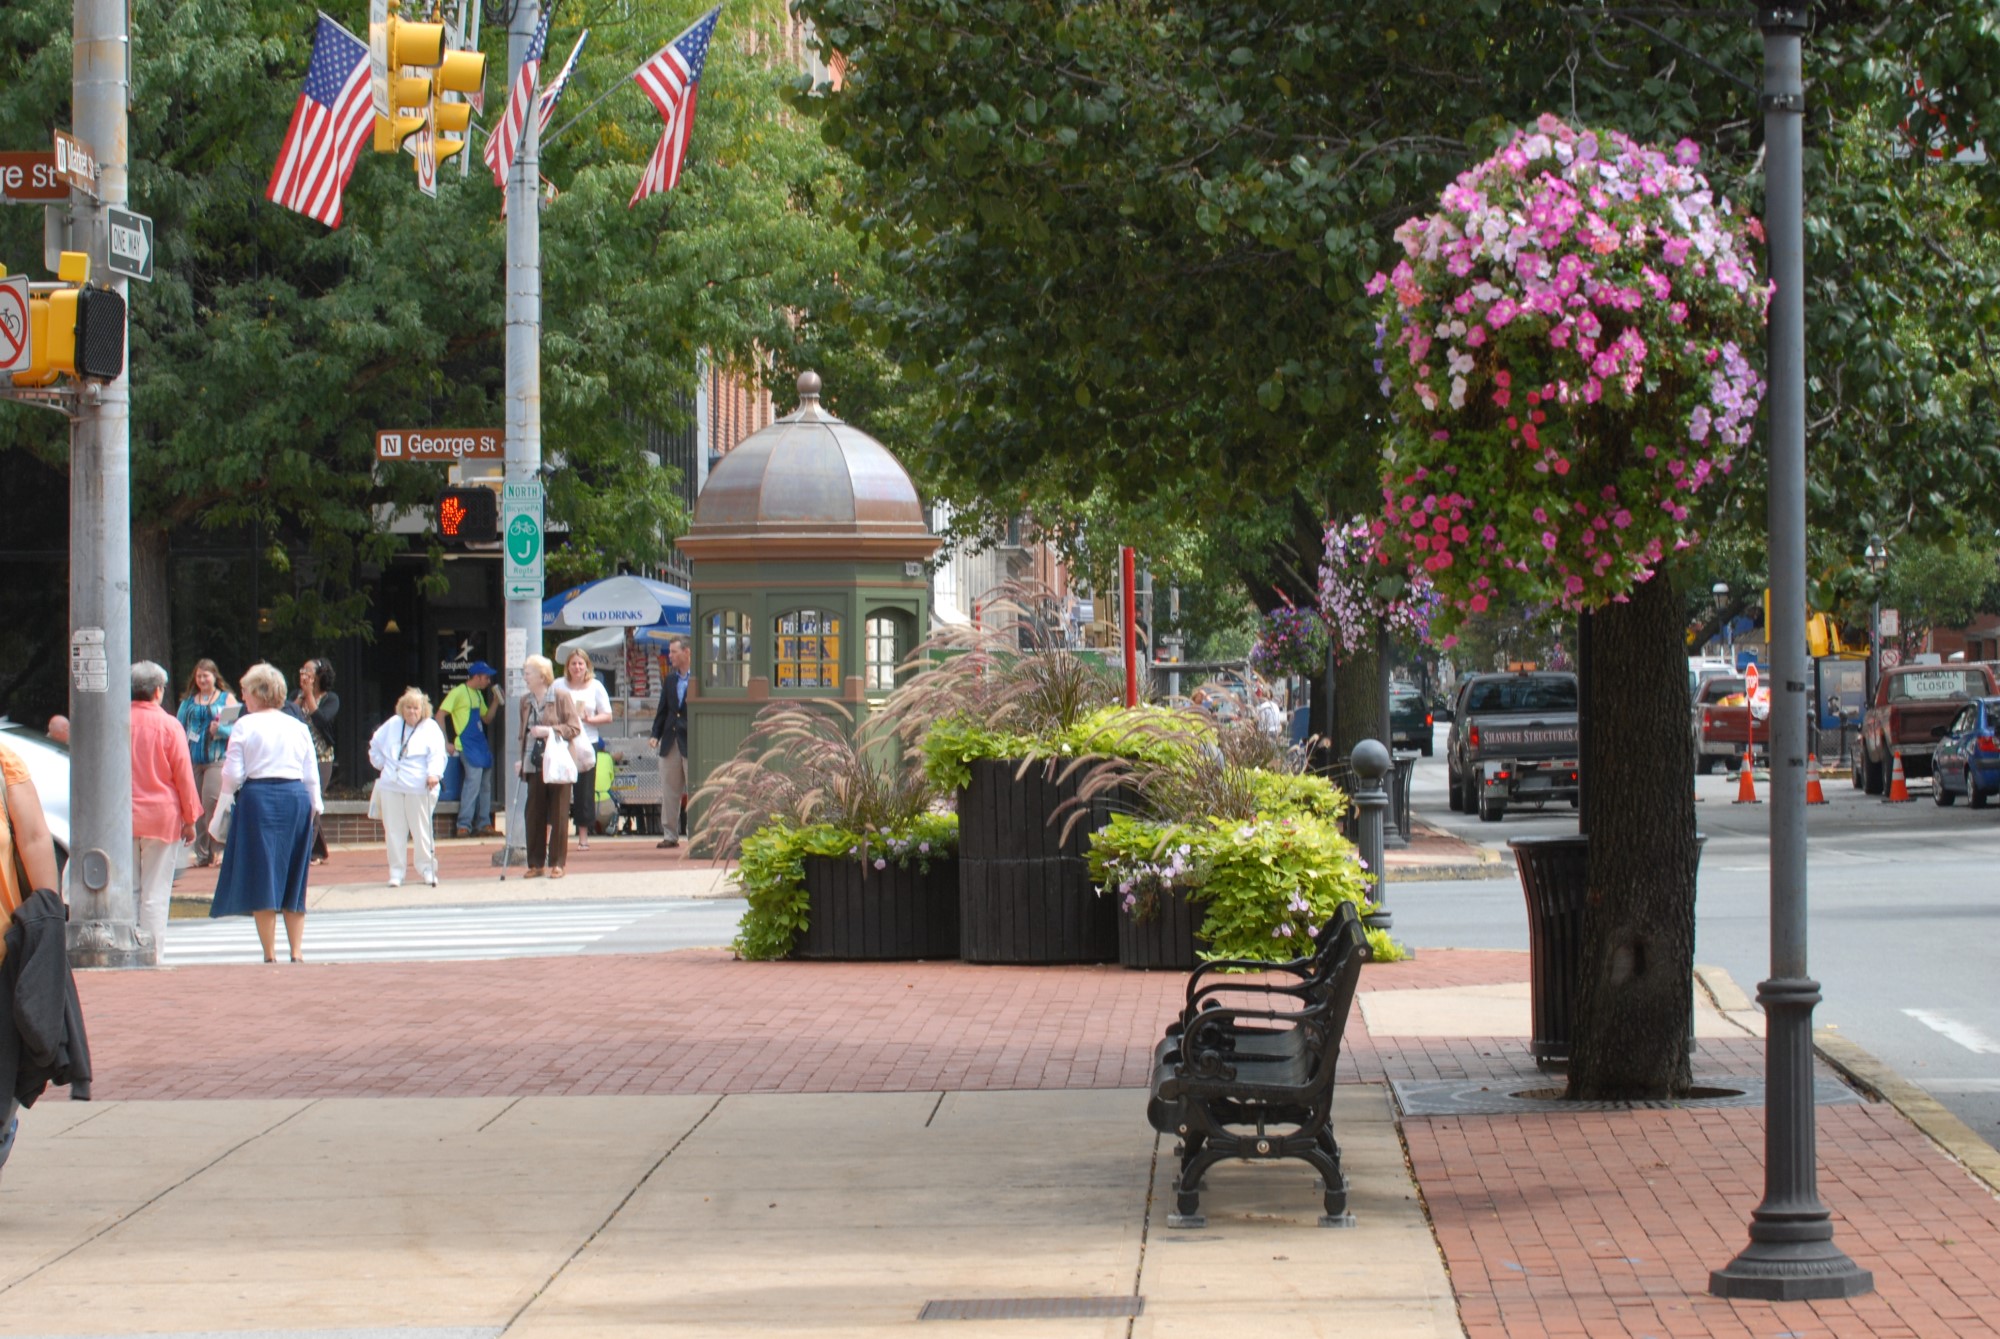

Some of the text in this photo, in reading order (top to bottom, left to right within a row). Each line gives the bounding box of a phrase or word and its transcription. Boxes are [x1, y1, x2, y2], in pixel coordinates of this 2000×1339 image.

[32, 163, 57, 188] St
[114, 227, 141, 257] ONE WAY
[384, 434, 496, 457] N George St
[508, 486, 538, 498] NORTH
[517, 540, 531, 559] J
[513, 566, 534, 574] Route
[582, 610, 643, 620] COLD DRINKS
[1747, 675, 1758, 689] STOP
[1916, 681, 1955, 692] CLOSED
[1484, 731, 1522, 744] SHAWNEE
